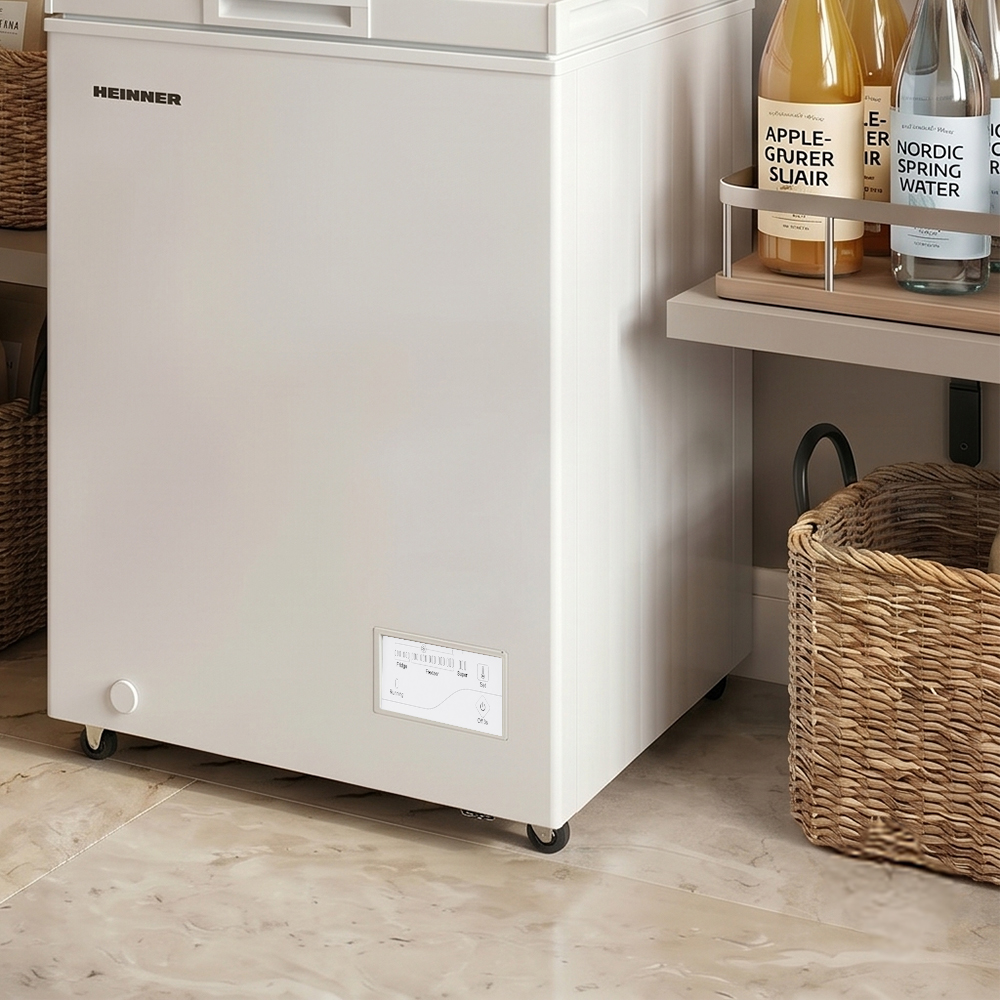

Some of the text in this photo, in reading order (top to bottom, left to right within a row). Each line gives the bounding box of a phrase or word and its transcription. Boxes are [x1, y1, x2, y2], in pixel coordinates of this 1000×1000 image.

[93, 85, 182, 106] HEINNER
[765, 126, 832, 146] APPLE-
[897, 139, 964, 160] NORDIC
[897, 158, 961, 179] SPRING
[899, 177, 960, 197] WATER
